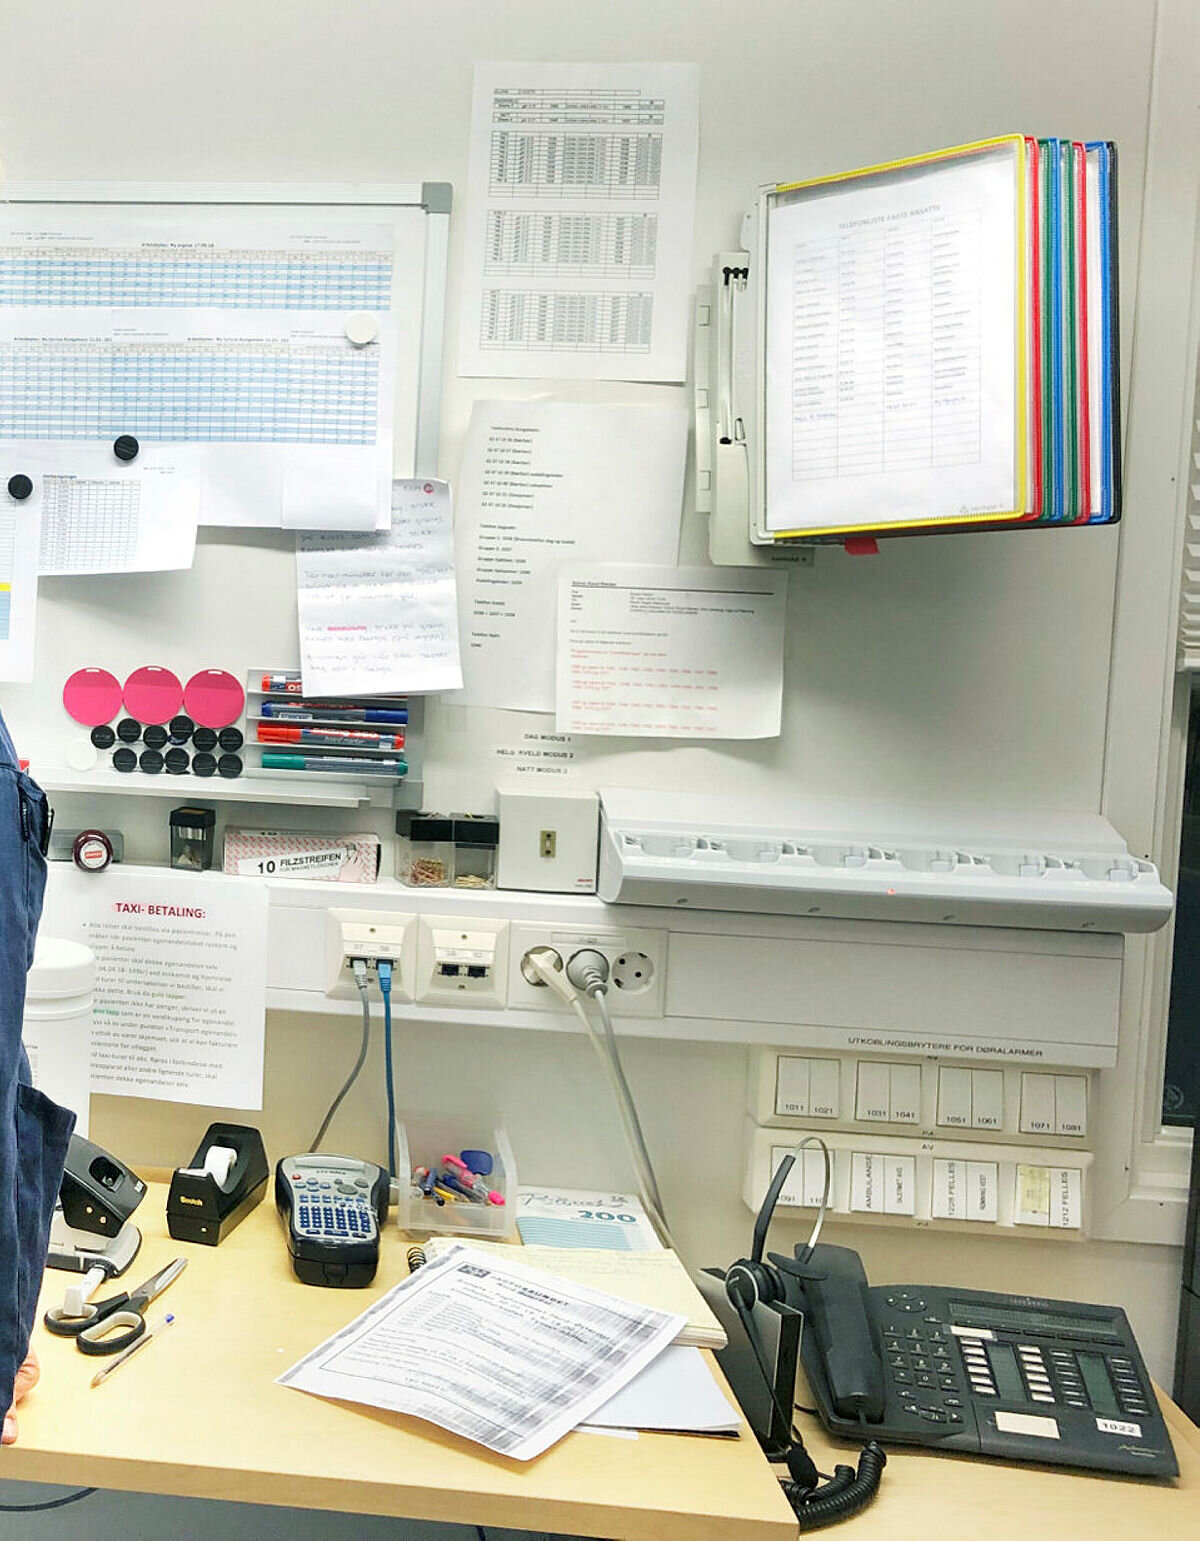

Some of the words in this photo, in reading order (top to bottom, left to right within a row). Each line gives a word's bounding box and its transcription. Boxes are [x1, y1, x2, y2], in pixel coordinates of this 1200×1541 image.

[257, 860, 276, 875] 10
[279, 852, 342, 867] FILZSTREIFEN
[115, 902, 145, 914] TAXI-
[147, 904, 207, 920] BETALING:
[954, 1044, 974, 1052] FOR
[785, 1103, 805, 1112] 1011
[813, 1106, 834, 1114] 1021
[180, 1195, 203, 1207] Scotch
[577, 1210, 637, 1223] 200
[1102, 1423, 1137, 1433] 1022
